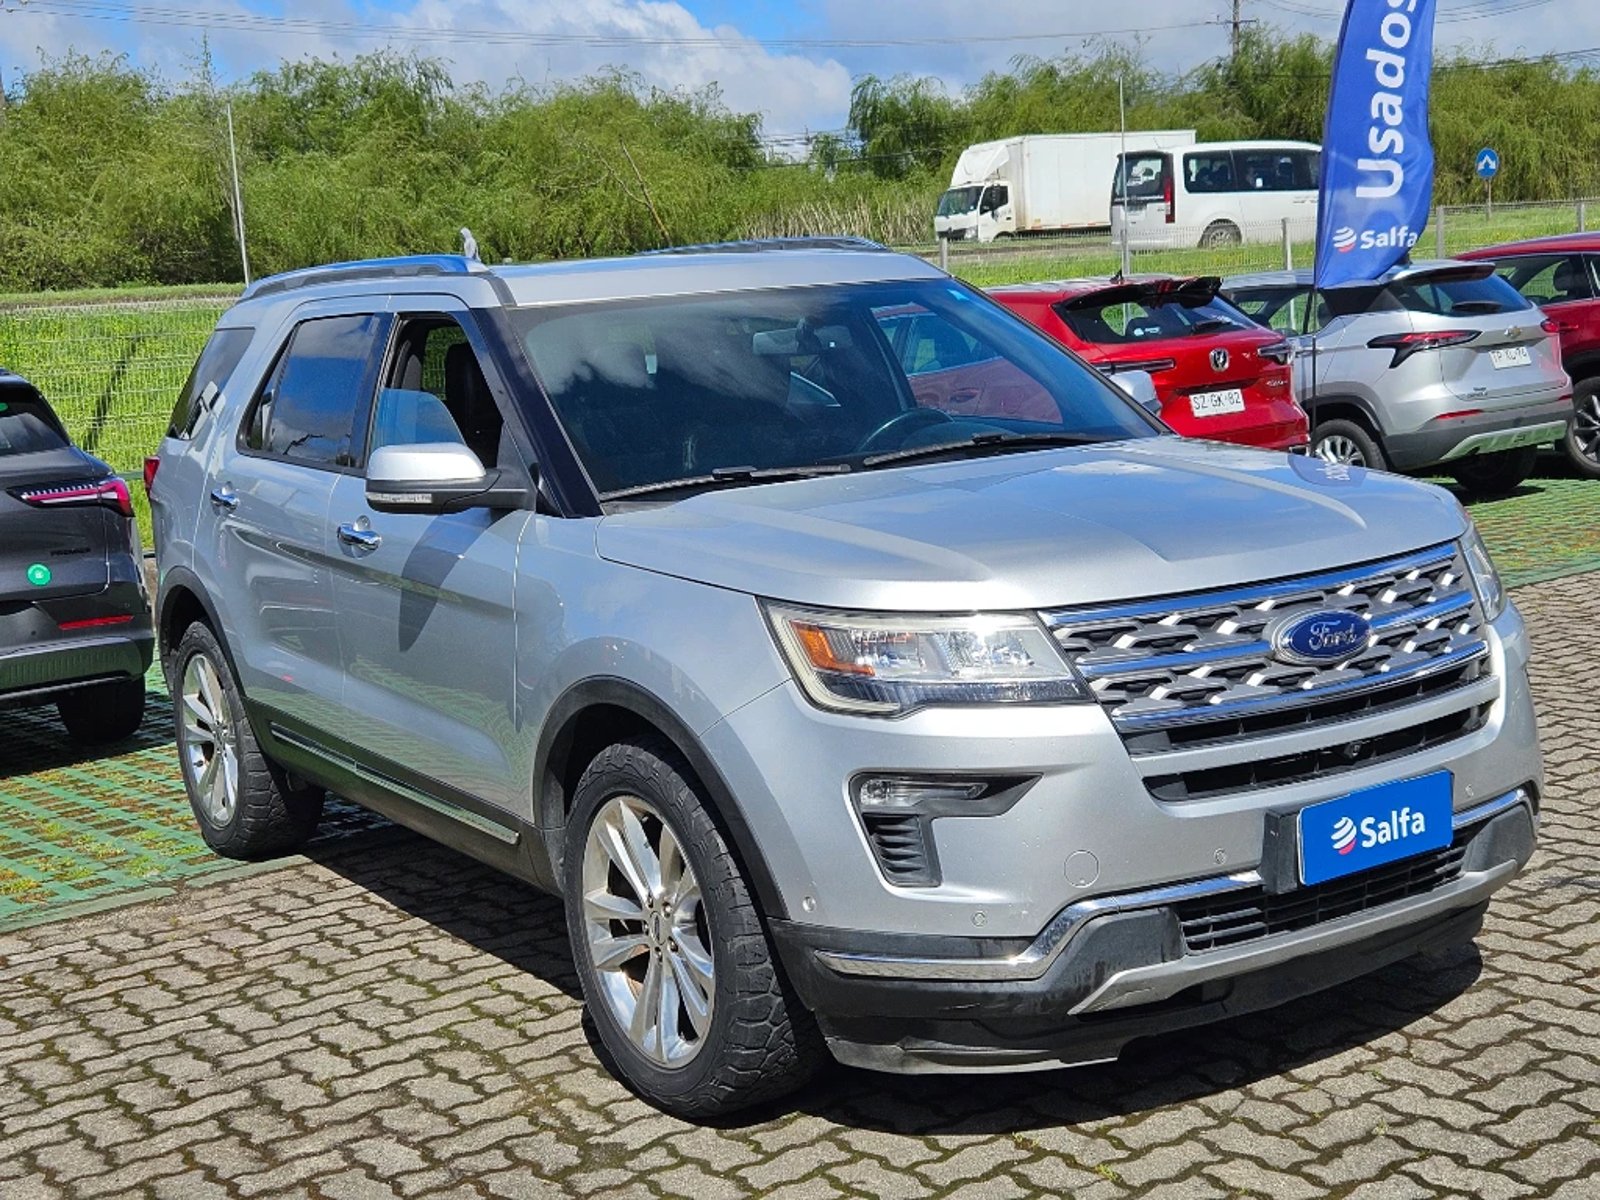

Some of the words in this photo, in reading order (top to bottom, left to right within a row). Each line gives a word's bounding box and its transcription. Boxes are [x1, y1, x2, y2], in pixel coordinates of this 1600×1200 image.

[1360, 225, 1418, 250] Salfa
[1309, 619, 1357, 651] Ford
[1360, 807, 1426, 848] Salfa
